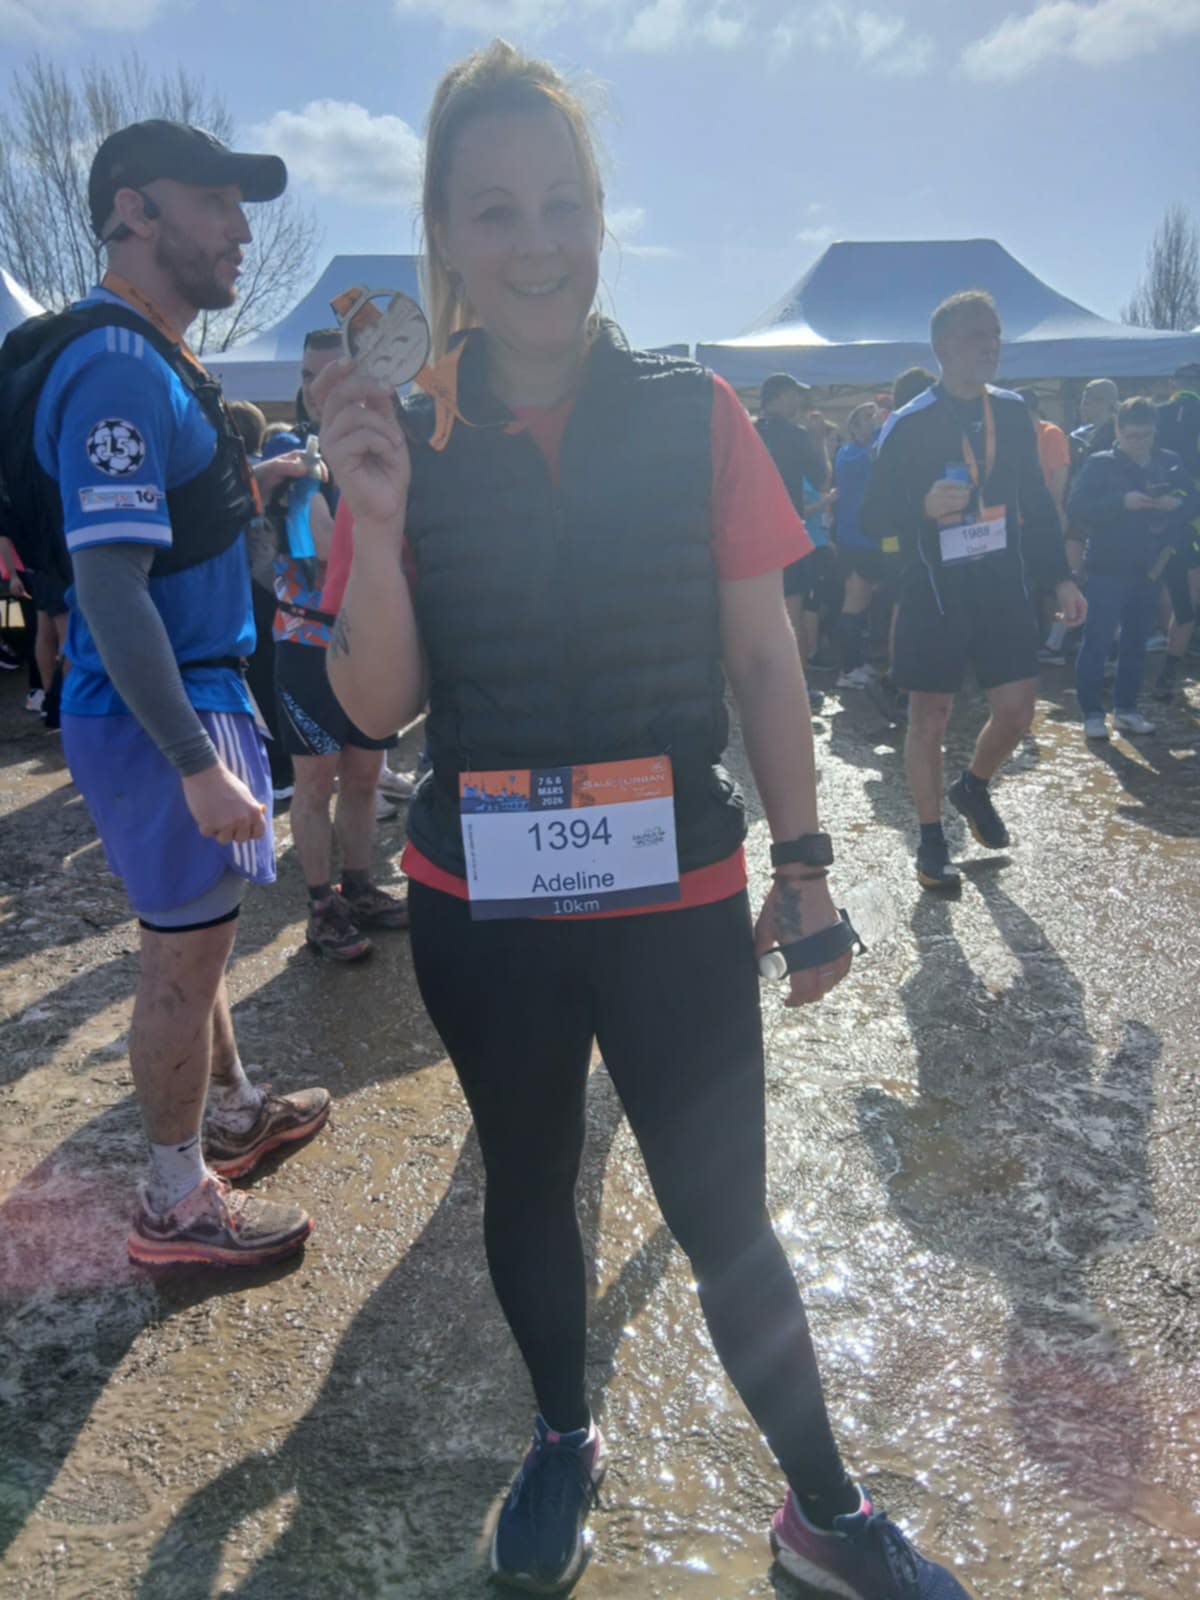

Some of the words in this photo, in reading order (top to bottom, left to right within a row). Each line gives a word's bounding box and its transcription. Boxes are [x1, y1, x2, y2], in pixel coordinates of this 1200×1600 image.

[102, 435, 129, 458] 15
[537, 776, 544, 786] 7
[537, 785, 564, 796] MARS
[527, 816, 612, 852] 1394
[531, 871, 615, 893] Adeline
[553, 897, 600, 914] 10km
